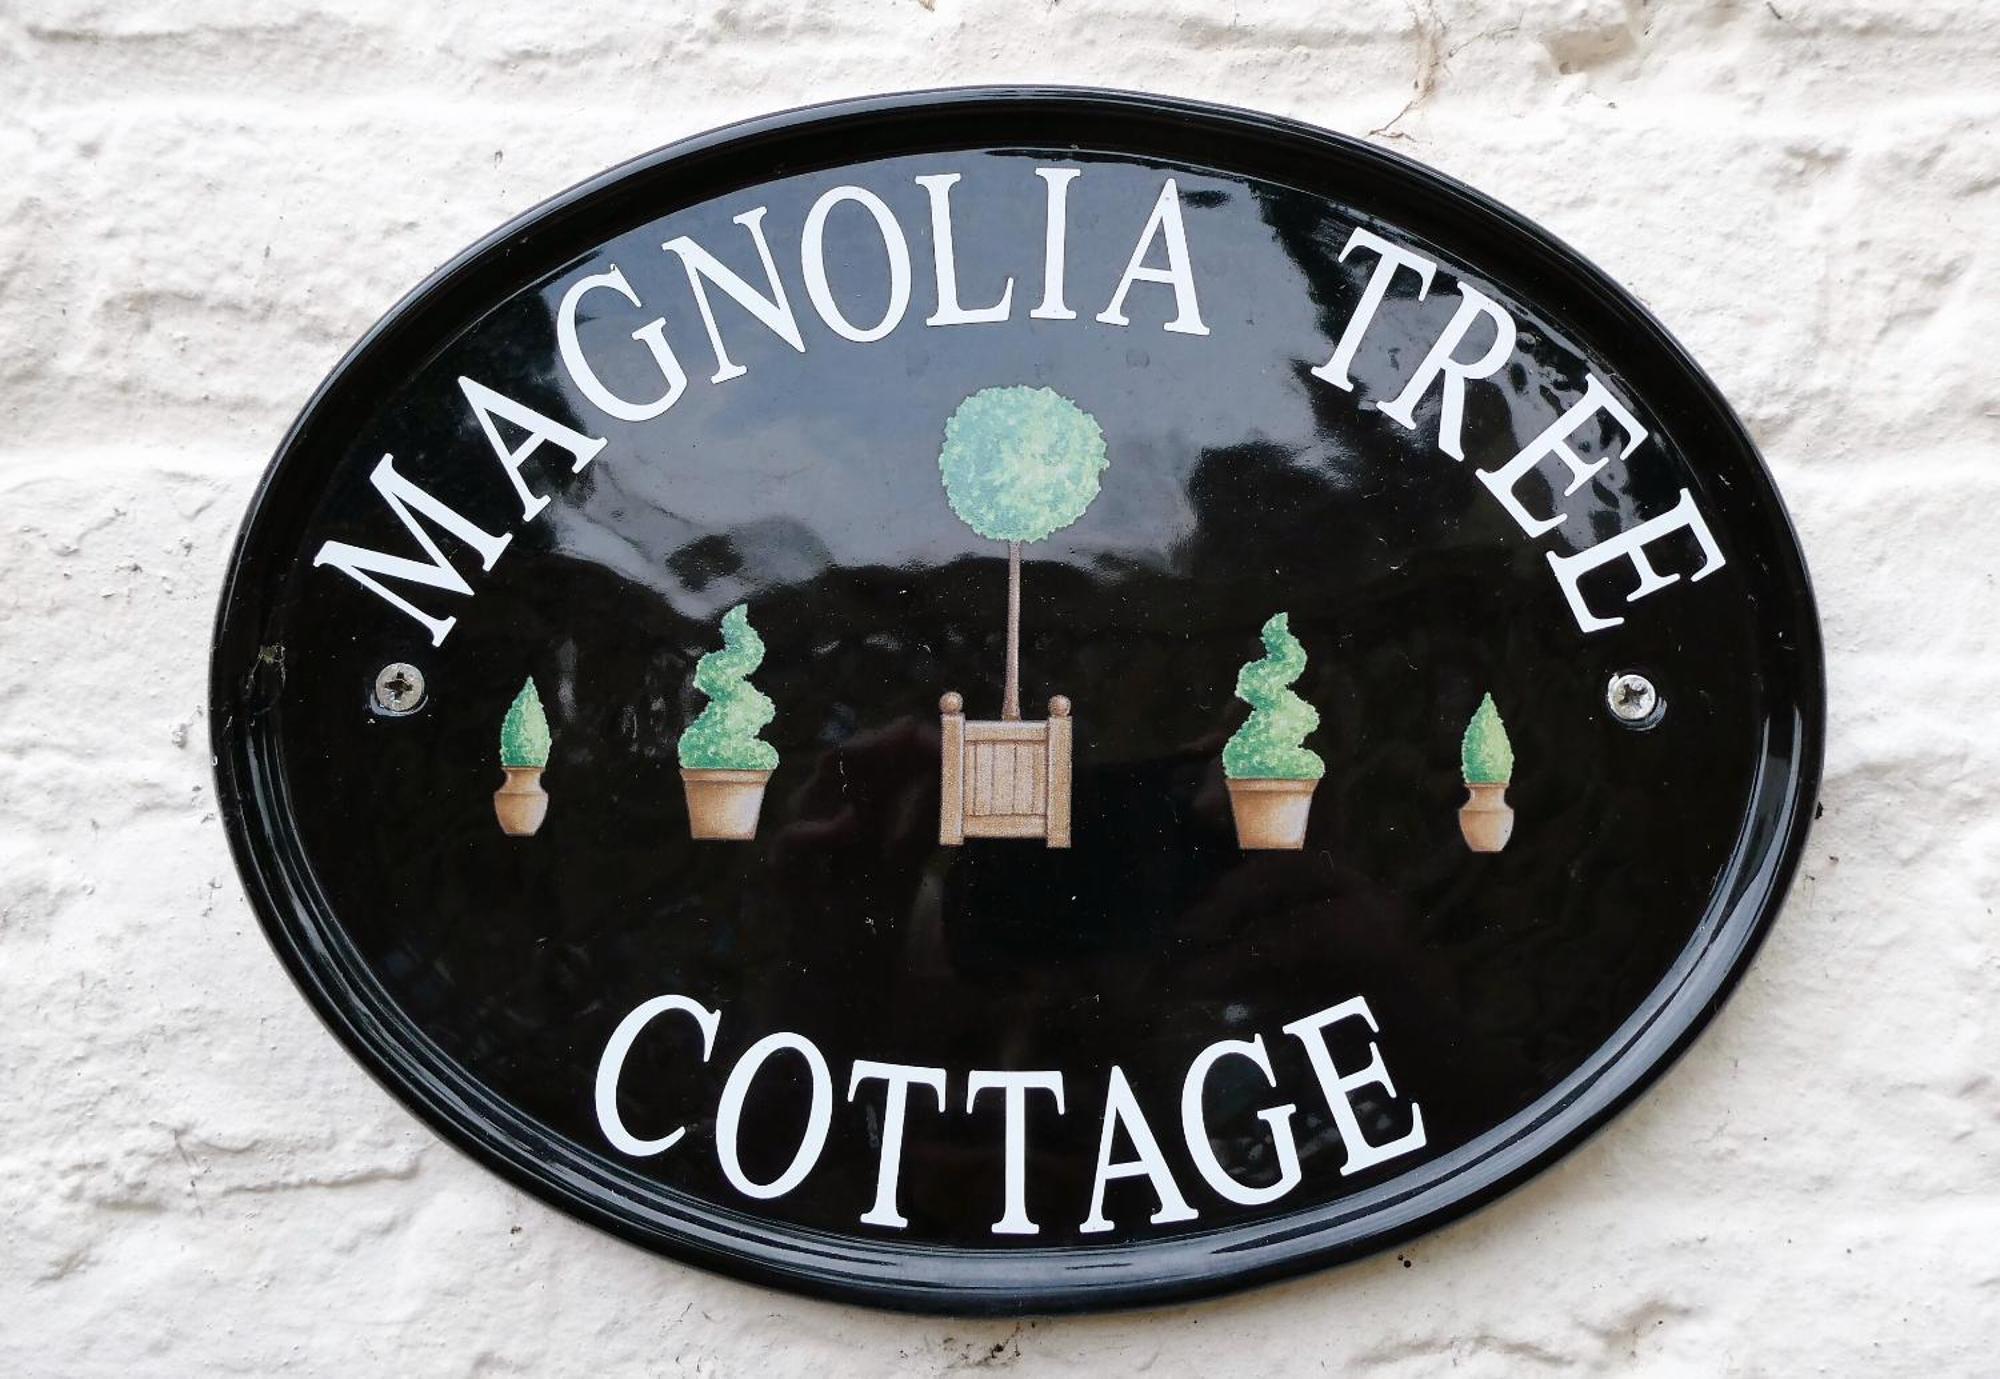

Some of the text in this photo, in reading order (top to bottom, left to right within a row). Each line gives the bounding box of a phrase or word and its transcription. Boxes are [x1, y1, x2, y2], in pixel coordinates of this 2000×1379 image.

[312, 166, 1727, 648] MAGNOLIA TREE
[595, 993, 1427, 1235] COTTAGE
